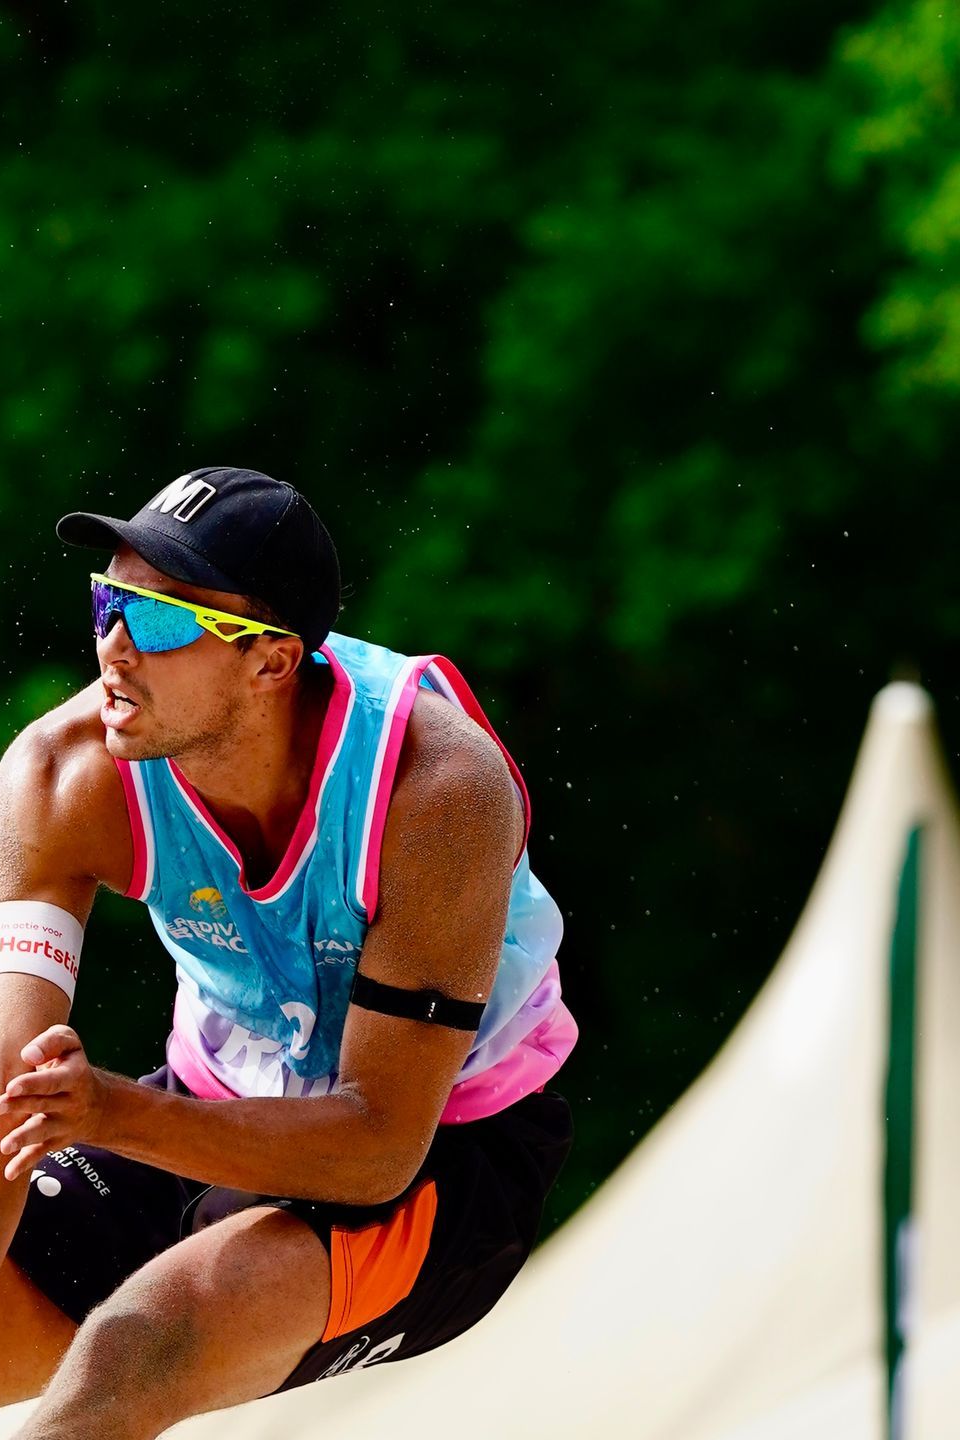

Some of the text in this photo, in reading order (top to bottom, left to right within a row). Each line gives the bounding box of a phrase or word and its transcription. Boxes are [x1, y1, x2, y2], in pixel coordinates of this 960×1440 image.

[13, 920, 39, 930] actie
[42, 926, 63, 938] voor
[165, 917, 240, 937] EREDIV
[62, 1145, 111, 1197] RLANDSE
